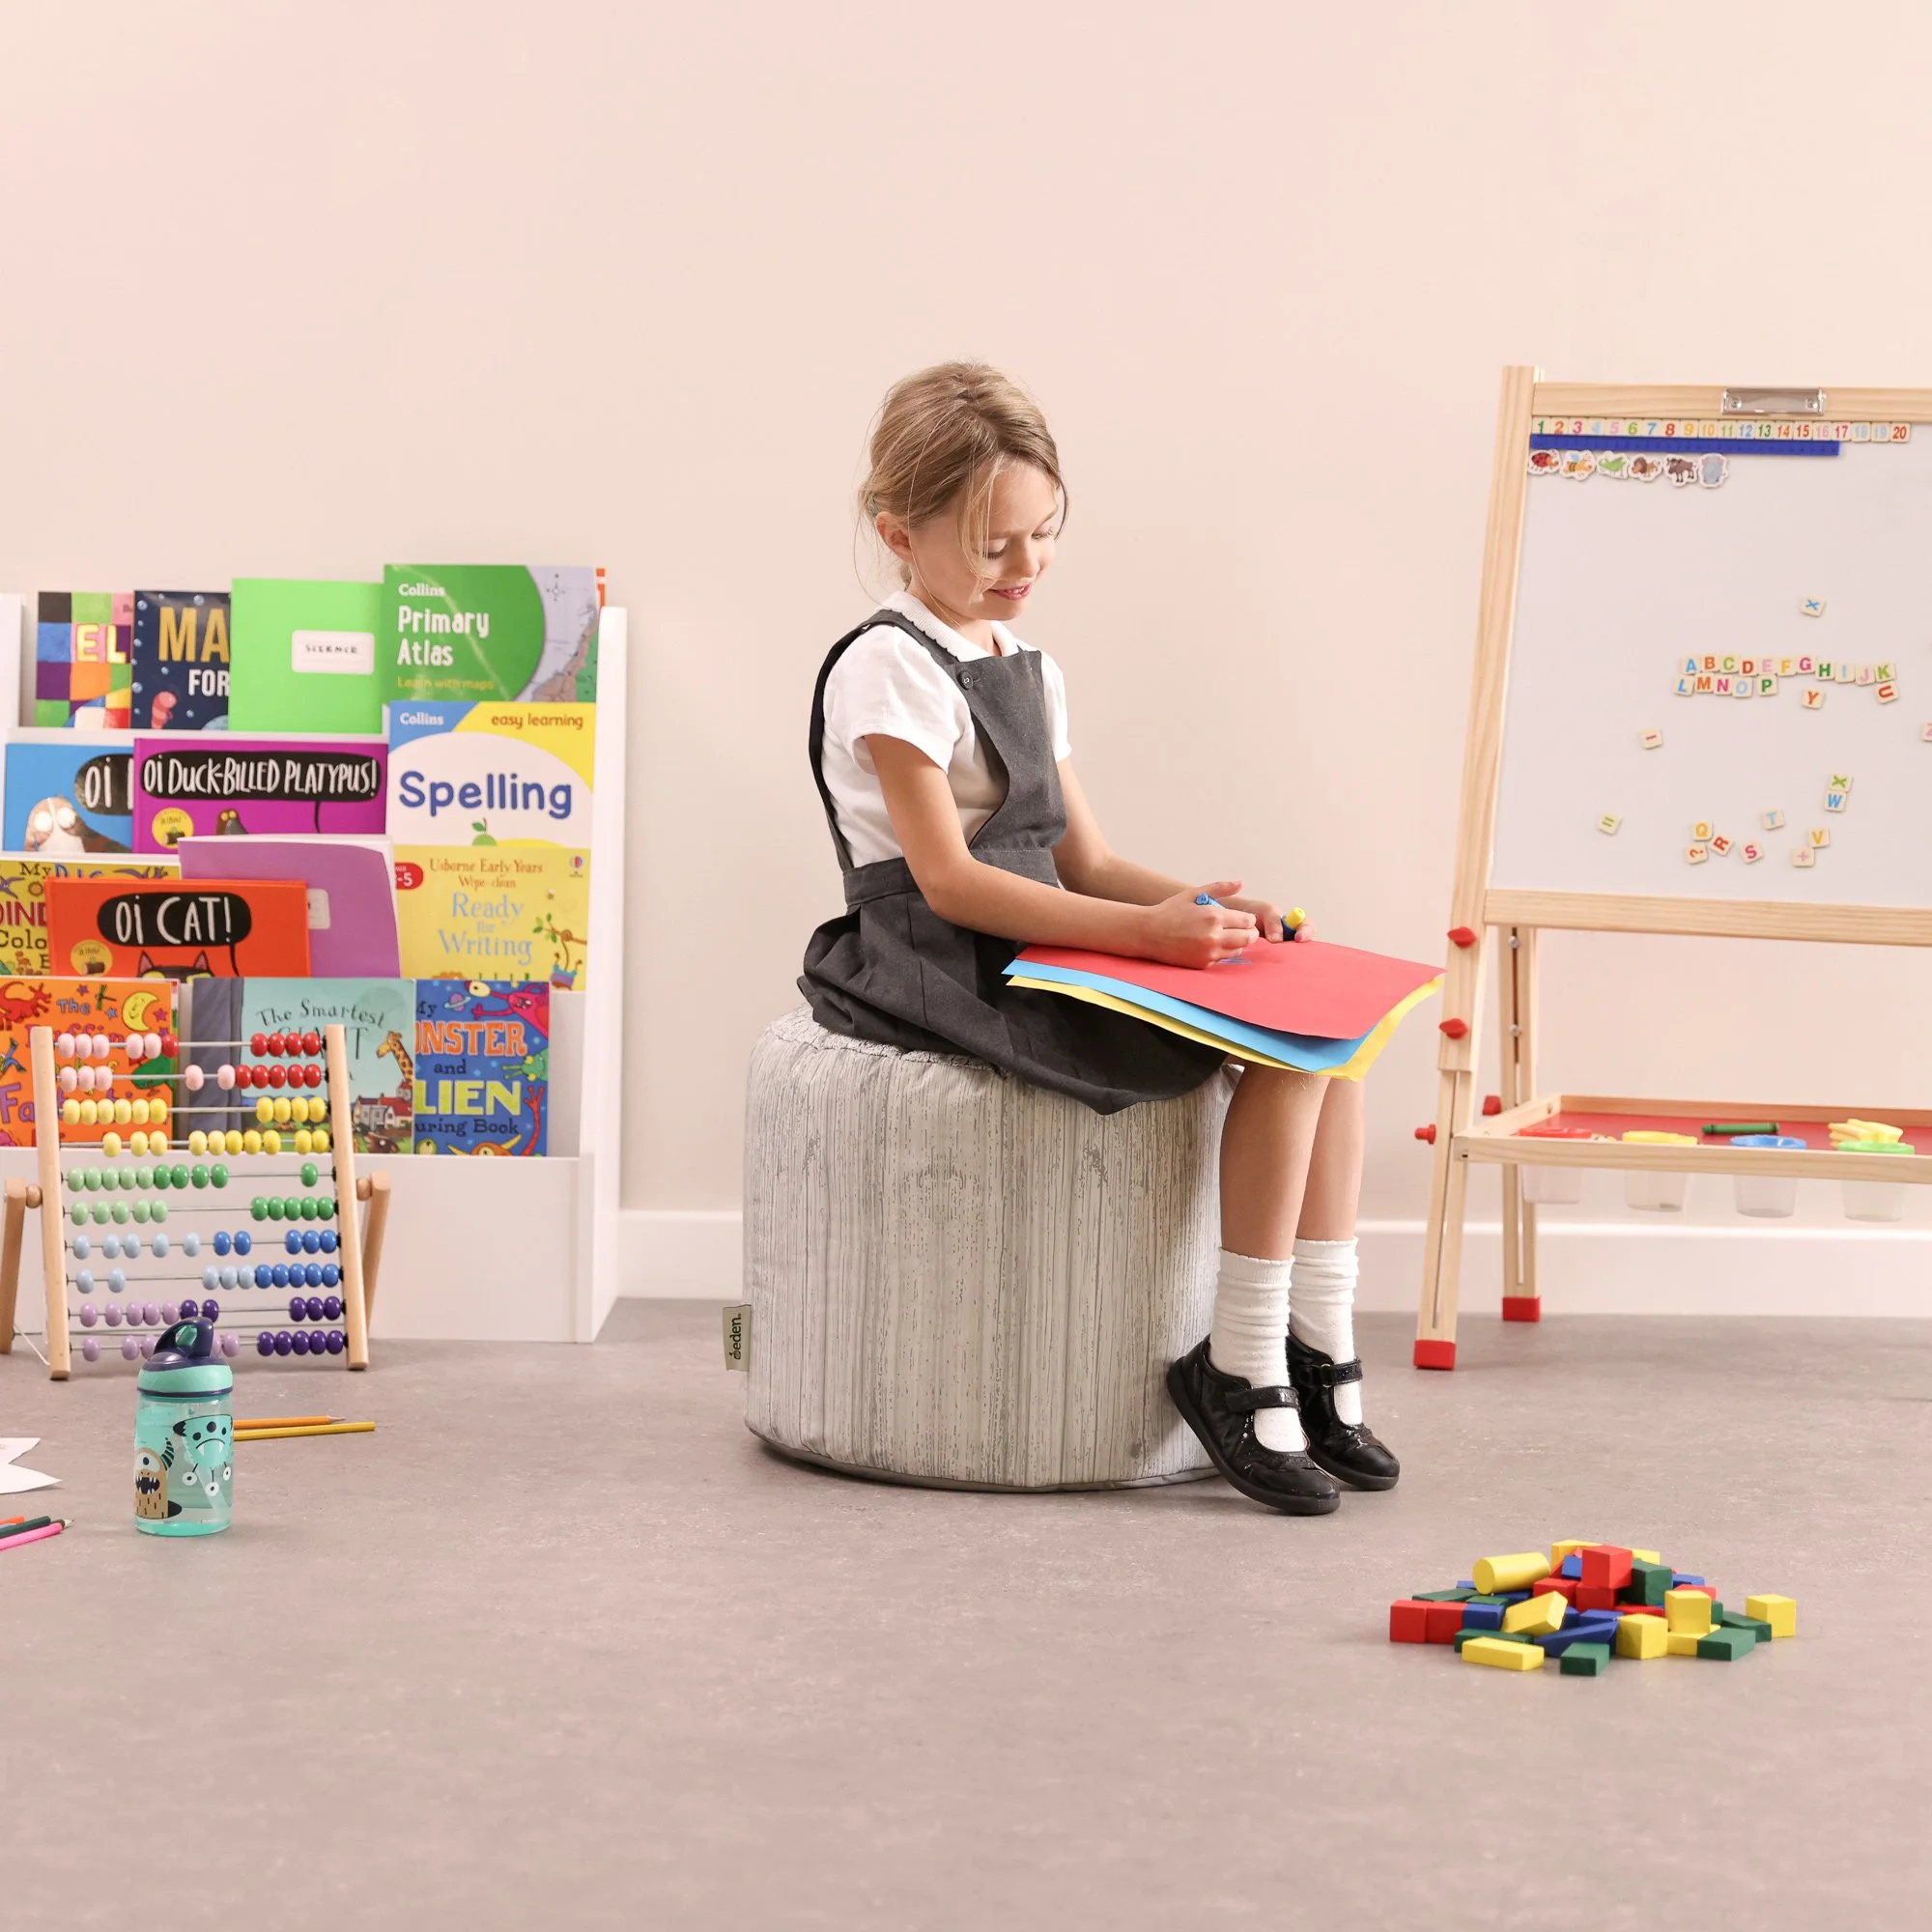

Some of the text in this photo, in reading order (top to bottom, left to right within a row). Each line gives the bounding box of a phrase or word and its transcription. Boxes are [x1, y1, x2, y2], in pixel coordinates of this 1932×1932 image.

[1538, 419, 1545, 434] 1
[1554, 420, 1565, 435] 2
[1573, 420, 1583, 435] 3
[1609, 421, 1619, 434] 5
[1628, 421, 1637, 435] 6
[1647, 422, 1658, 436] 7
[1665, 423, 1675, 437] 8
[1684, 423, 1694, 436] 9
[1702, 423, 1715, 437] 10
[1721, 424, 1733, 437] 11
[1739, 424, 1752, 437] 12
[1758, 424, 1772, 438] 13
[1777, 425, 1790, 438] 14
[1797, 425, 1809, 438] 15
[1835, 425, 1848, 439] 17
[1892, 426, 1907, 440] 20
[397, 582, 446, 597] Collins
[397, 605, 490, 639] Primary
[396, 638, 454, 667] Atlas
[435, 678, 462, 689] with
[463, 679, 496, 692] maps
[1807, 691, 1820, 705] Y
[399, 711, 445, 726] Collins
[491, 712, 584, 730] easy learning
[283, 757, 378, 798] PLATYPUS!
[398, 770, 572, 820] Spelling
[1827, 793, 1843, 809] W
[1765, 811, 1776, 826] T
[1811, 831, 1825, 845] V
[19, 861, 52, 880] My
[429, 858, 544, 878] Usborne Early Years
[452, 892, 526, 927] Ready
[156, 895, 232, 945] CAT!
[476, 921, 497, 933] for
[438, 929, 533, 966] Writing
[56, 997, 91, 1015] The
[255, 998, 386, 1029] The Smartest
[433, 1059, 468, 1075] and
[473, 1118, 520, 1135] Book
